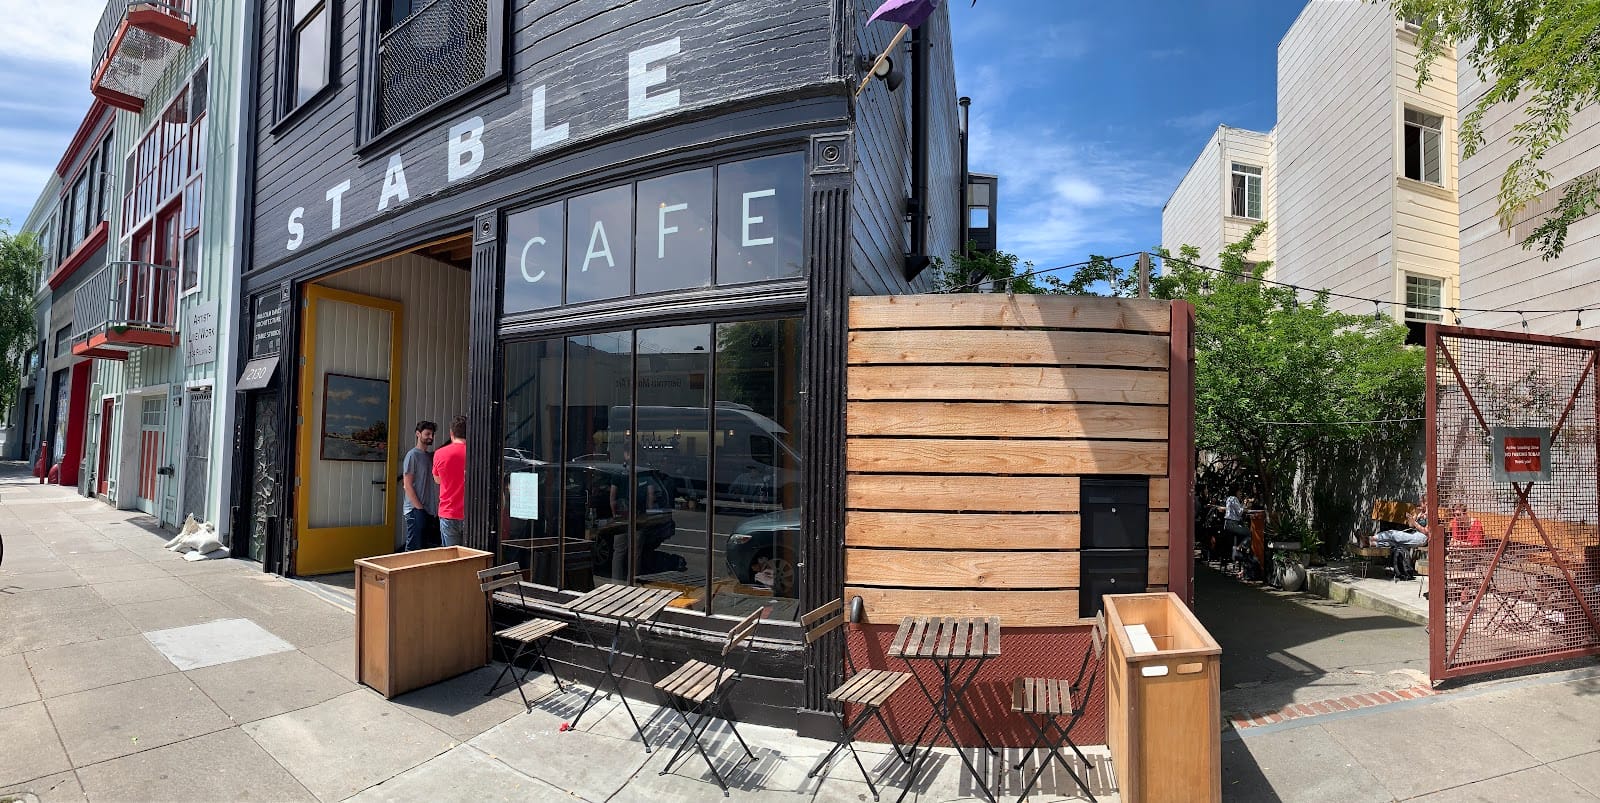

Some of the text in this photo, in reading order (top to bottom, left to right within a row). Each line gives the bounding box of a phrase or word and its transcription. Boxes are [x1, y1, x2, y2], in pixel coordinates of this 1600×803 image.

[286, 36, 681, 251] STABLE
[520, 188, 776, 283] CAFE
[246, 367, 267, 381] 2130
